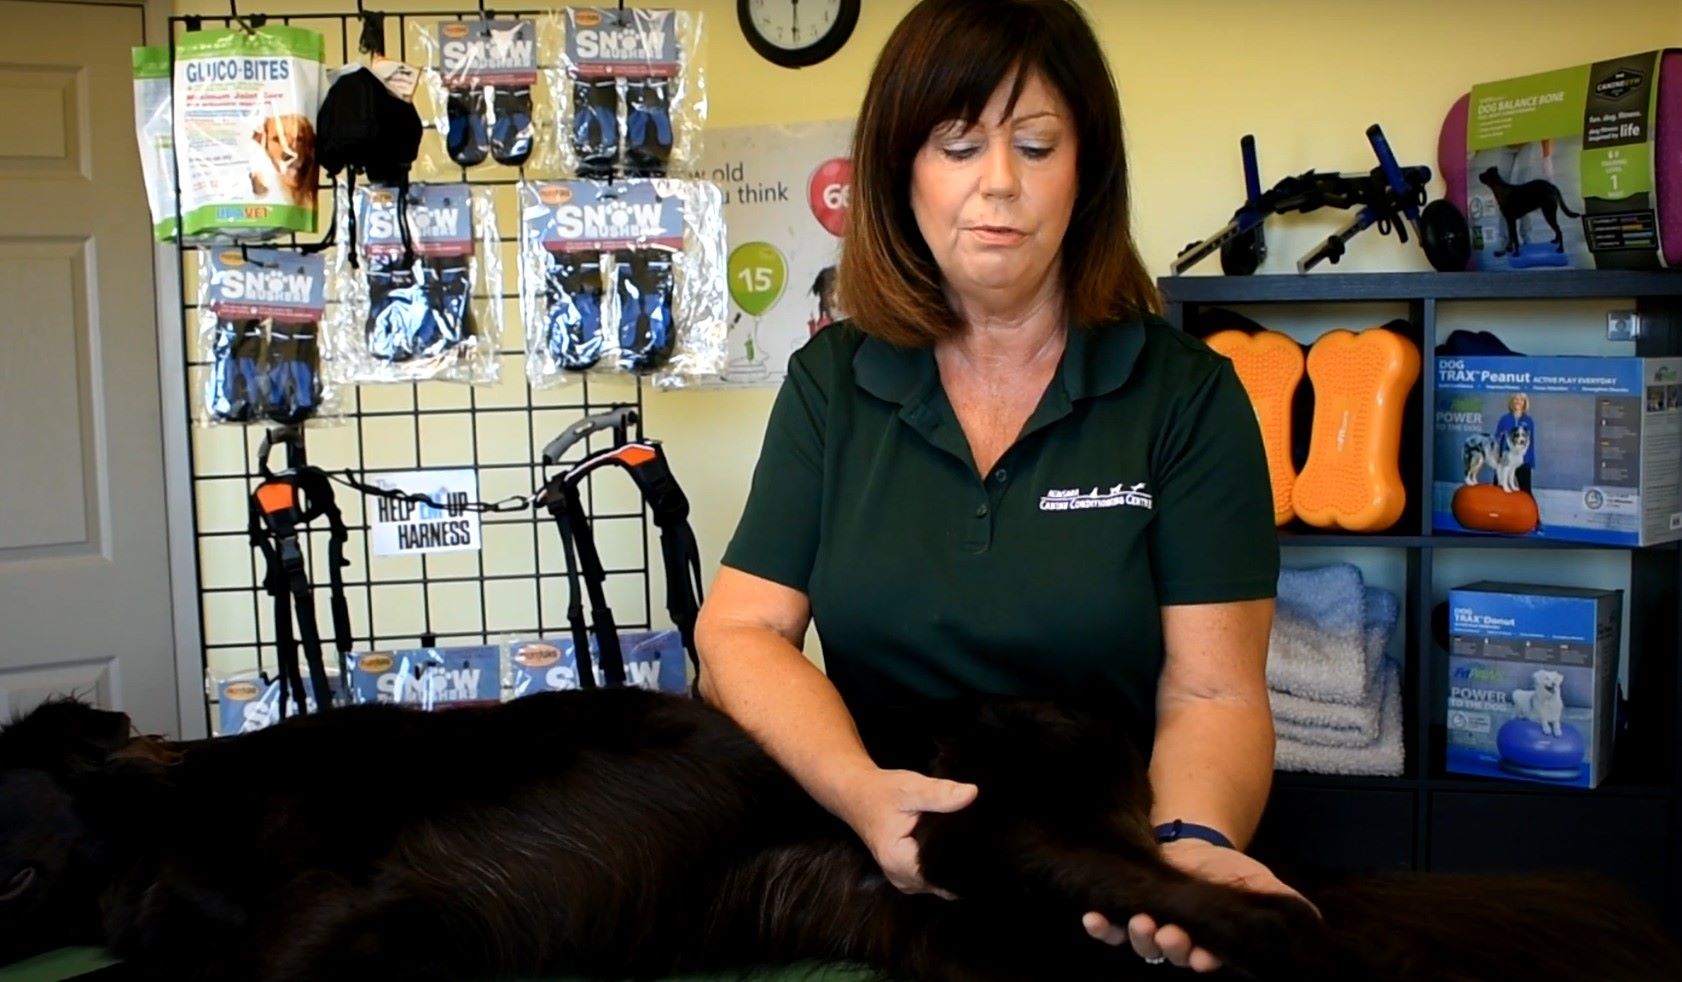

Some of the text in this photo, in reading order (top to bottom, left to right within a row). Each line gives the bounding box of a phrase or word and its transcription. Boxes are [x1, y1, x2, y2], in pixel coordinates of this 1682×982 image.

[186, 59, 289, 83] GLUCO-BITES
[1620, 123, 1640, 138] life
[1610, 175, 1618, 191] 1
[738, 182, 788, 203] think
[220, 269, 313, 303] SNOW
[738, 268, 773, 292] 15
[1439, 360, 1465, 370] DOG
[1481, 370, 1531, 384] Peanut
[1436, 412, 1482, 424] POWER
[378, 490, 415, 523] HELP
[446, 491, 468, 518] UP
[397, 520, 471, 550] HARNESS
[1451, 687, 1506, 703] POWER
